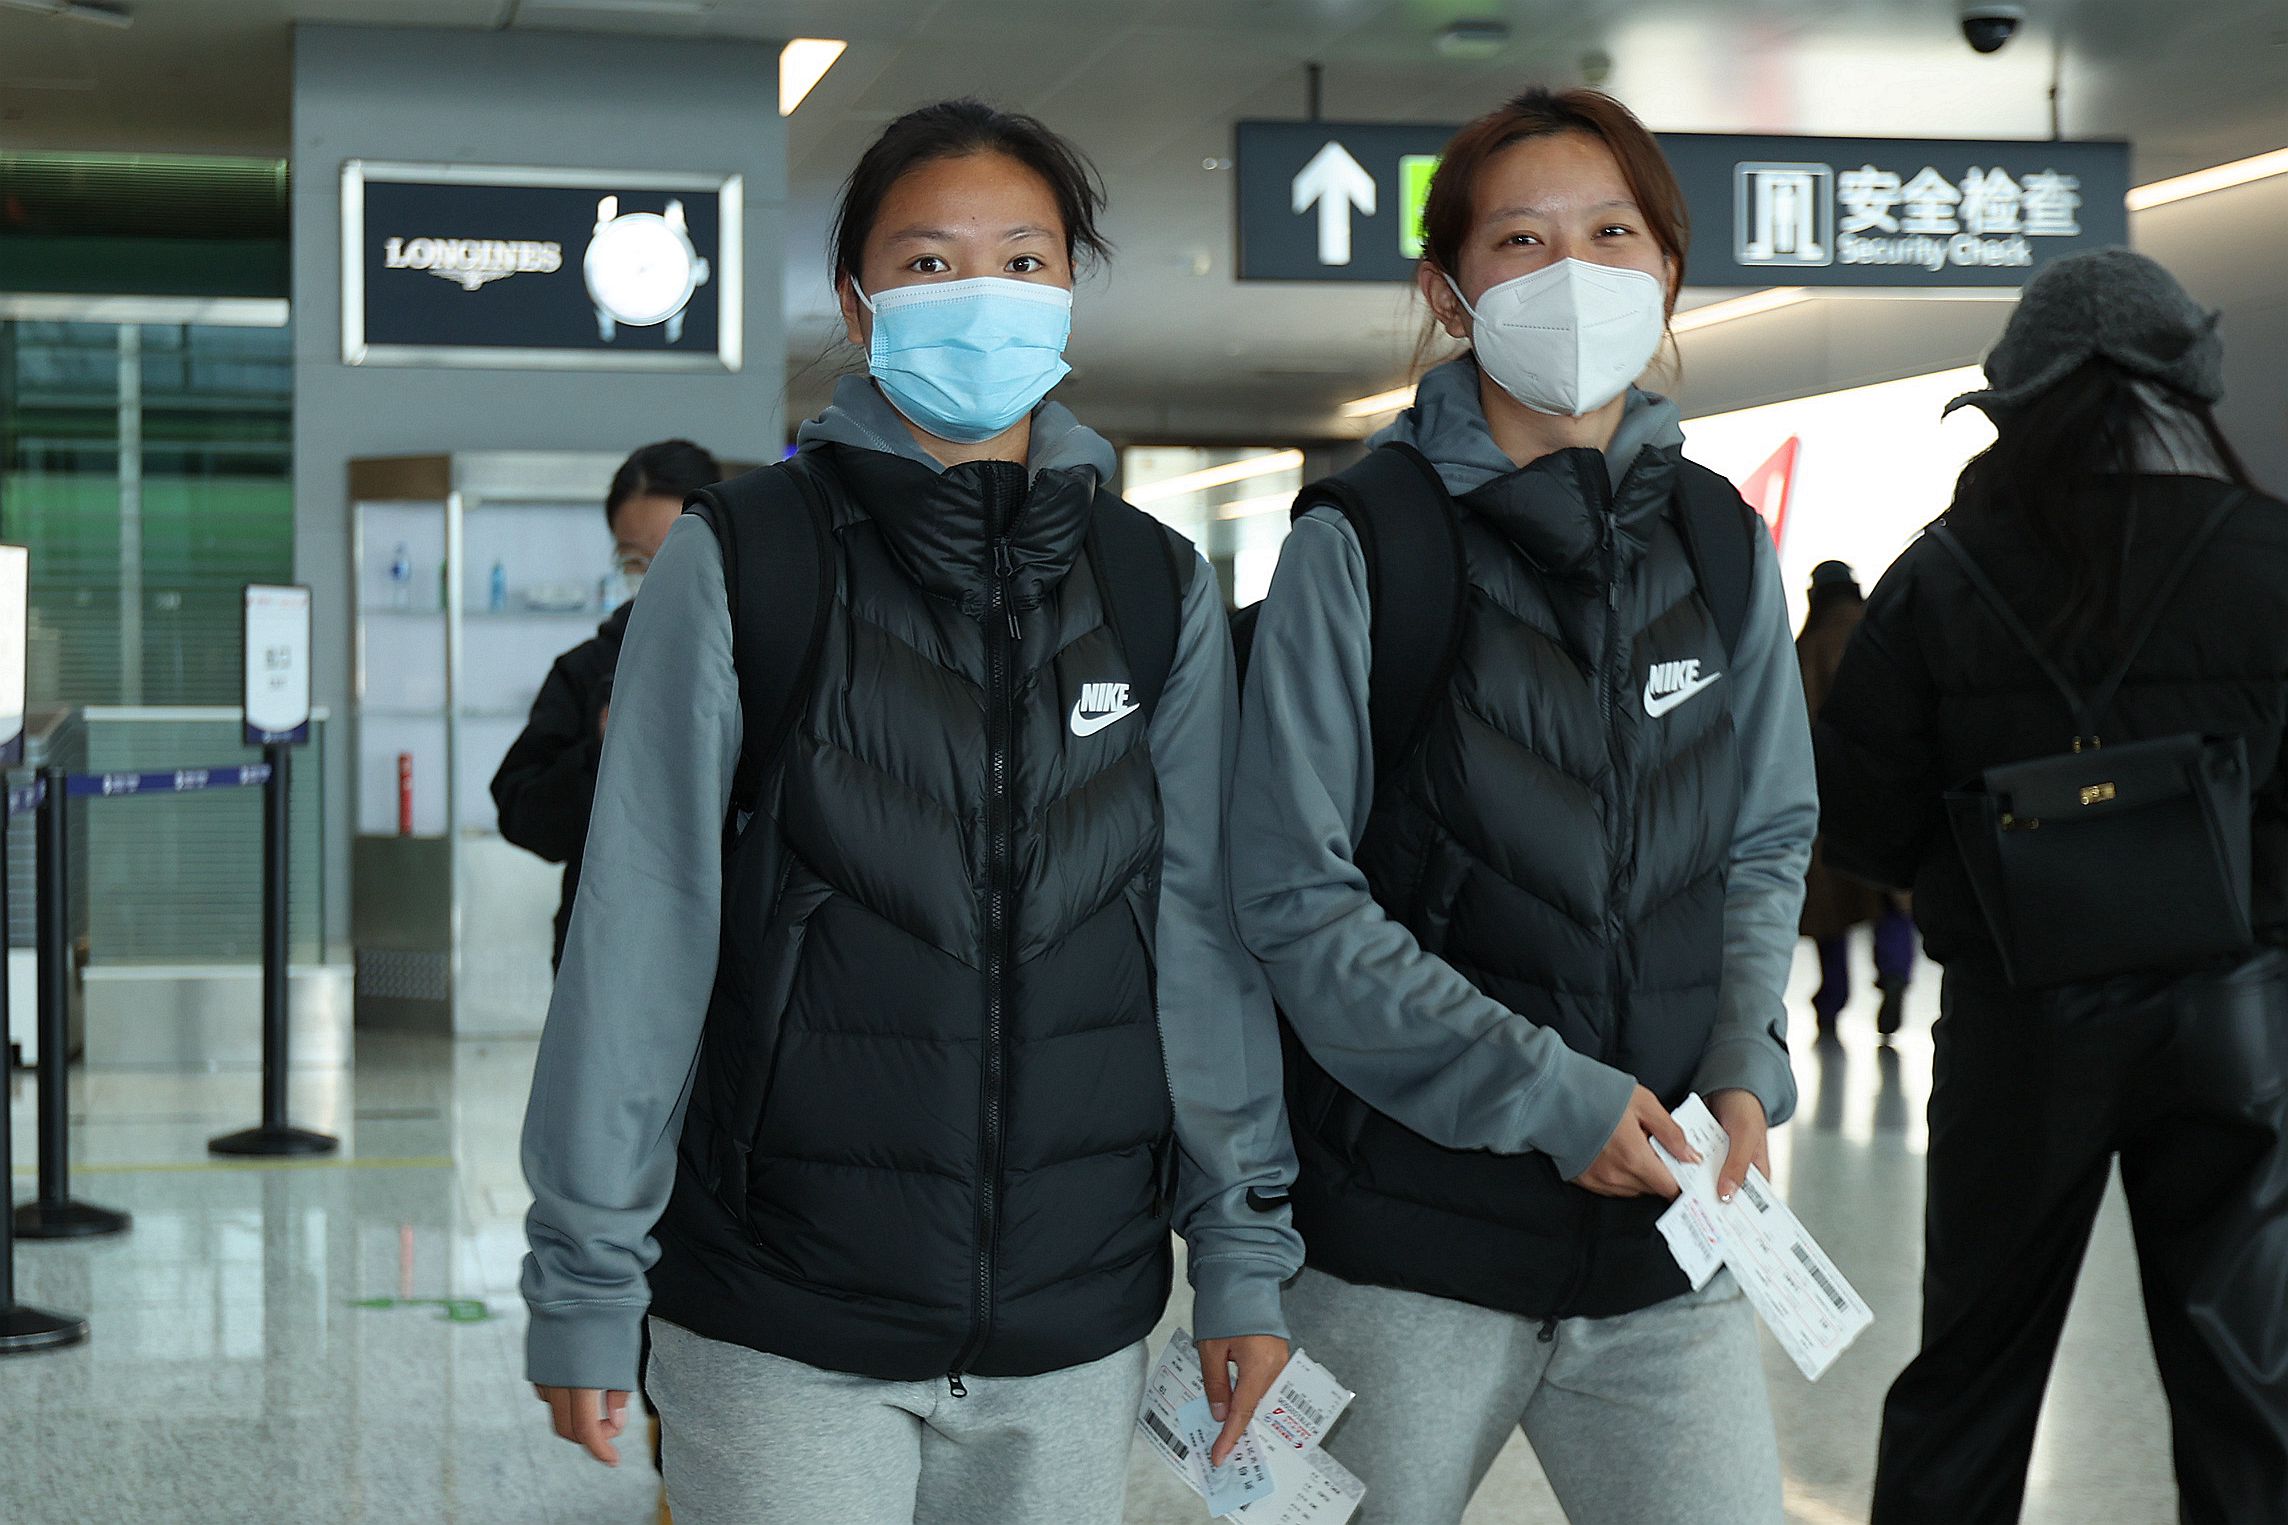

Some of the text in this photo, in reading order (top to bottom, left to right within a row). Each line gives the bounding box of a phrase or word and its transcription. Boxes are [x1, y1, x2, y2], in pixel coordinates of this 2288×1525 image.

[1836, 163, 2083, 236] 安全检查
[384, 236, 563, 274] LONGINES
[1836, 232, 2034, 272] Security Check
[1648, 658, 1701, 694] NIKE
[1080, 682, 1130, 712] NIKE
